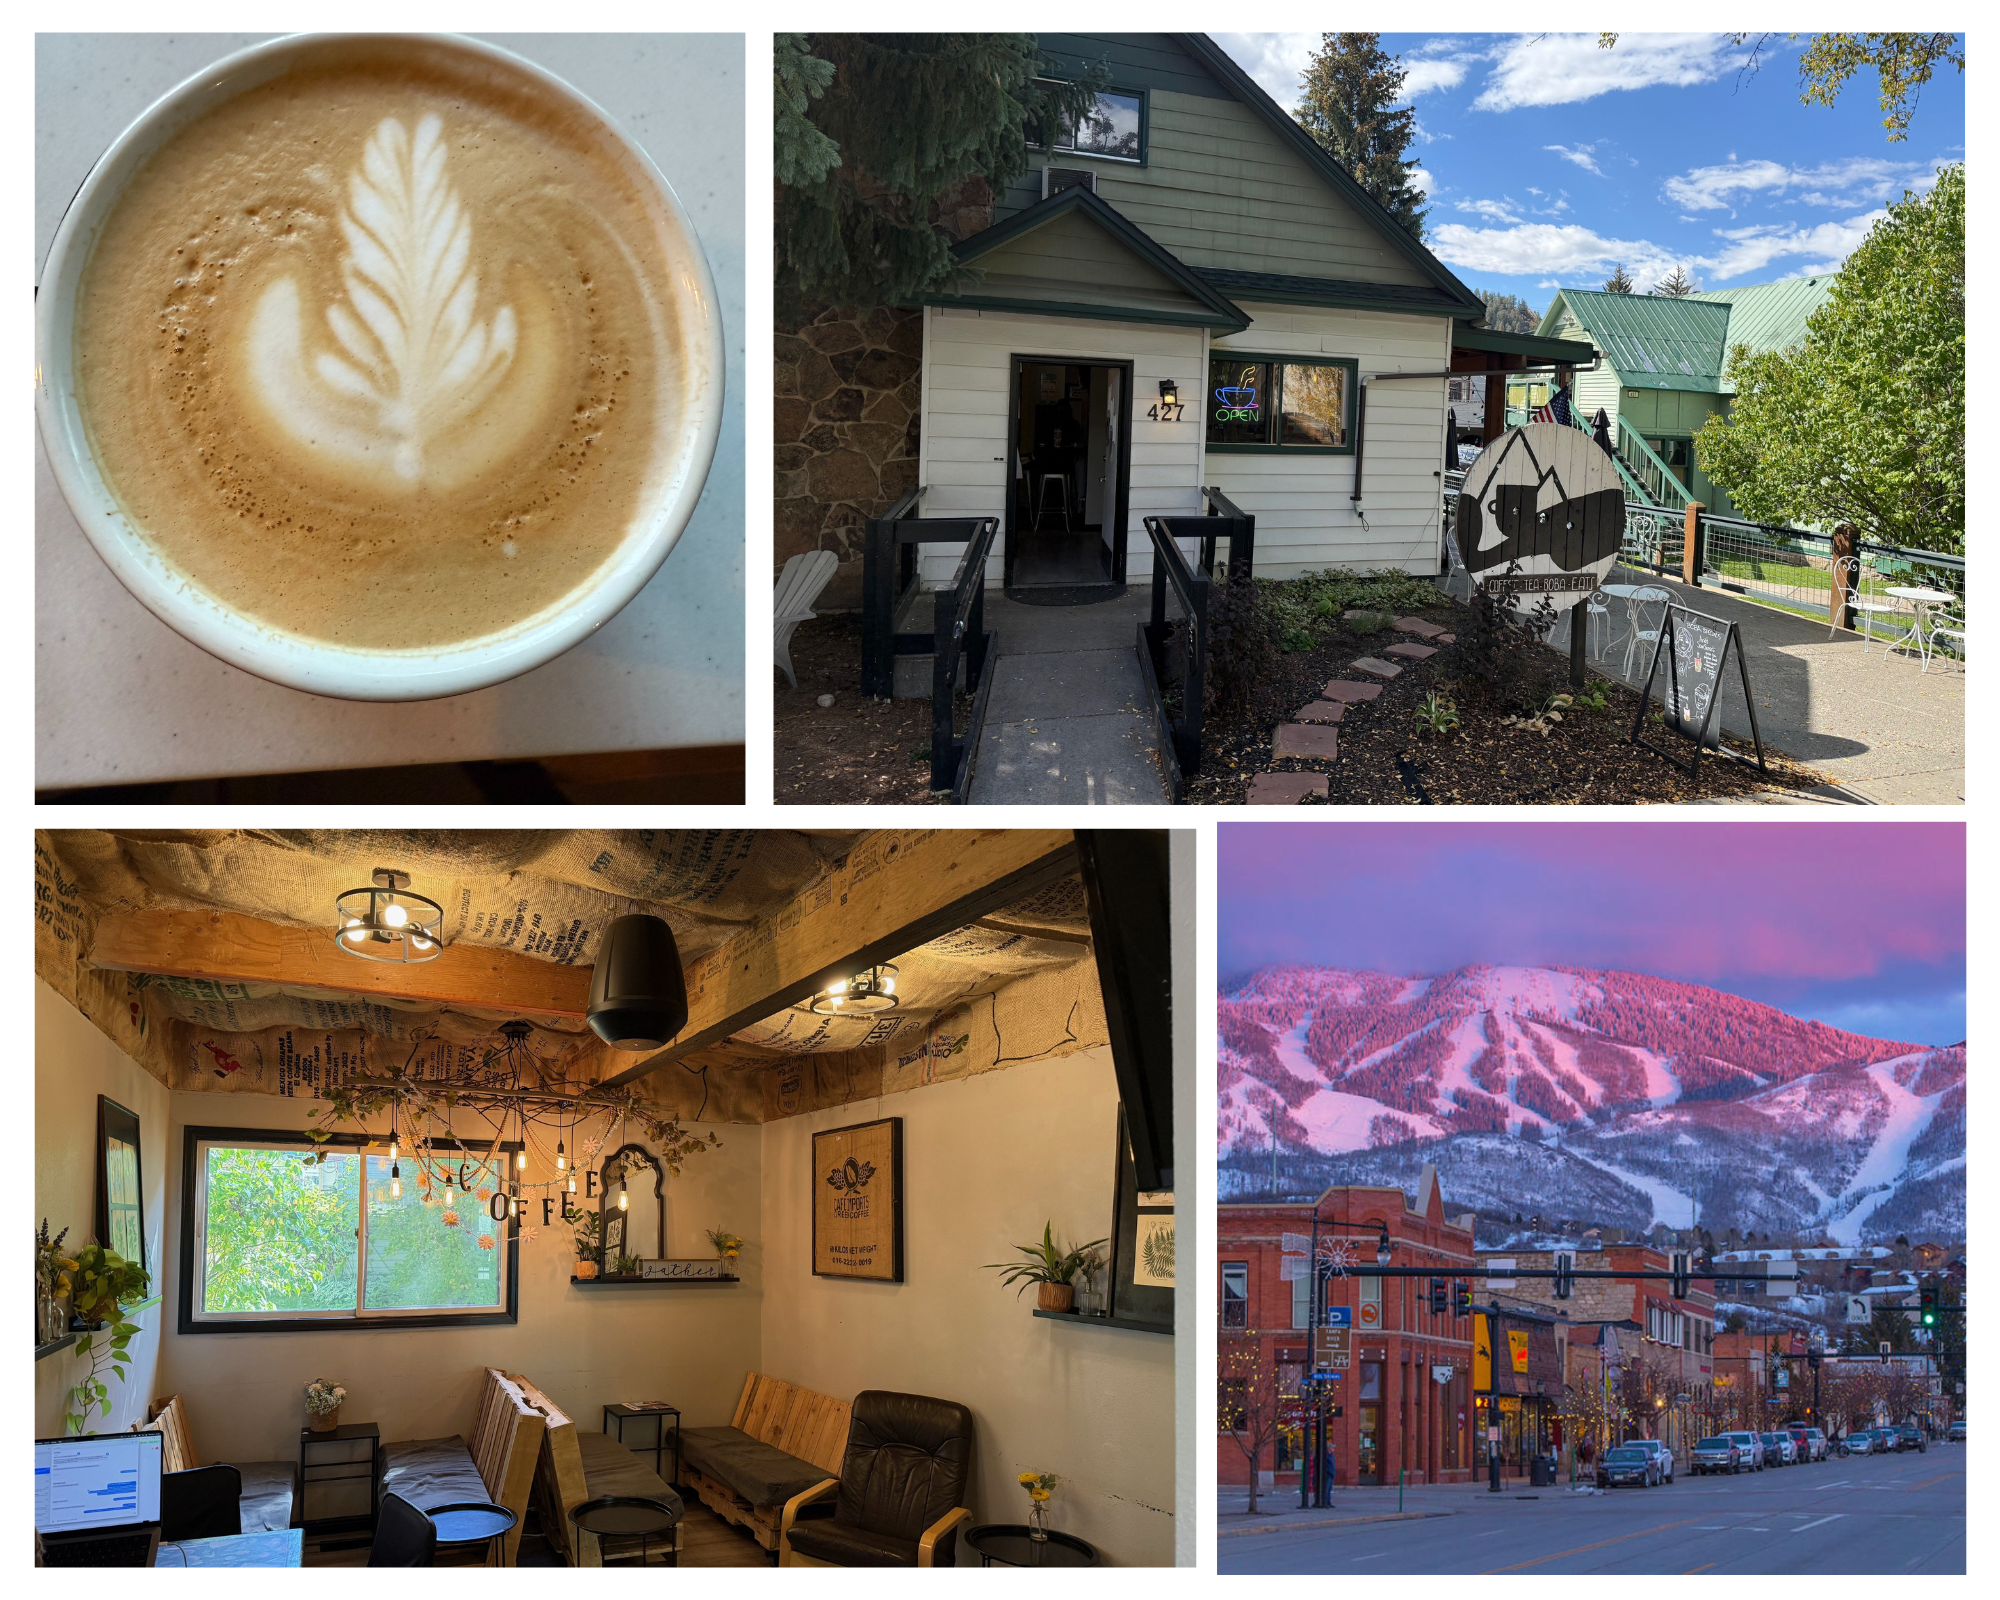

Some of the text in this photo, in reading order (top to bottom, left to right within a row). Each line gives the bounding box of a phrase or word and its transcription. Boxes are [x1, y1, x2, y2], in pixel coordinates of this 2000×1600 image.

[1148, 404, 1185, 421] 427
[1216, 409, 1259, 422] OPEN
[1524, 579, 1540, 591] TEA
[1544, 578, 1566, 591] BOBA
[1572, 577, 1596, 591] EATS
[568, 919, 581, 942] GREEN
[286, 1031, 294, 1054] BEANS
[325, 1034, 333, 1042] by
[294, 1054, 302, 1078] Capitan
[834, 1195, 870, 1212] CAFE IMPORTS
[850, 1210, 869, 1219] COFFEE
[835, 1246, 849, 1254] KILOS
[859, 1245, 877, 1254] WEIGHT
[645, 1262, 717, 1278] gather
[1330, 1312, 1342, 1322] P
